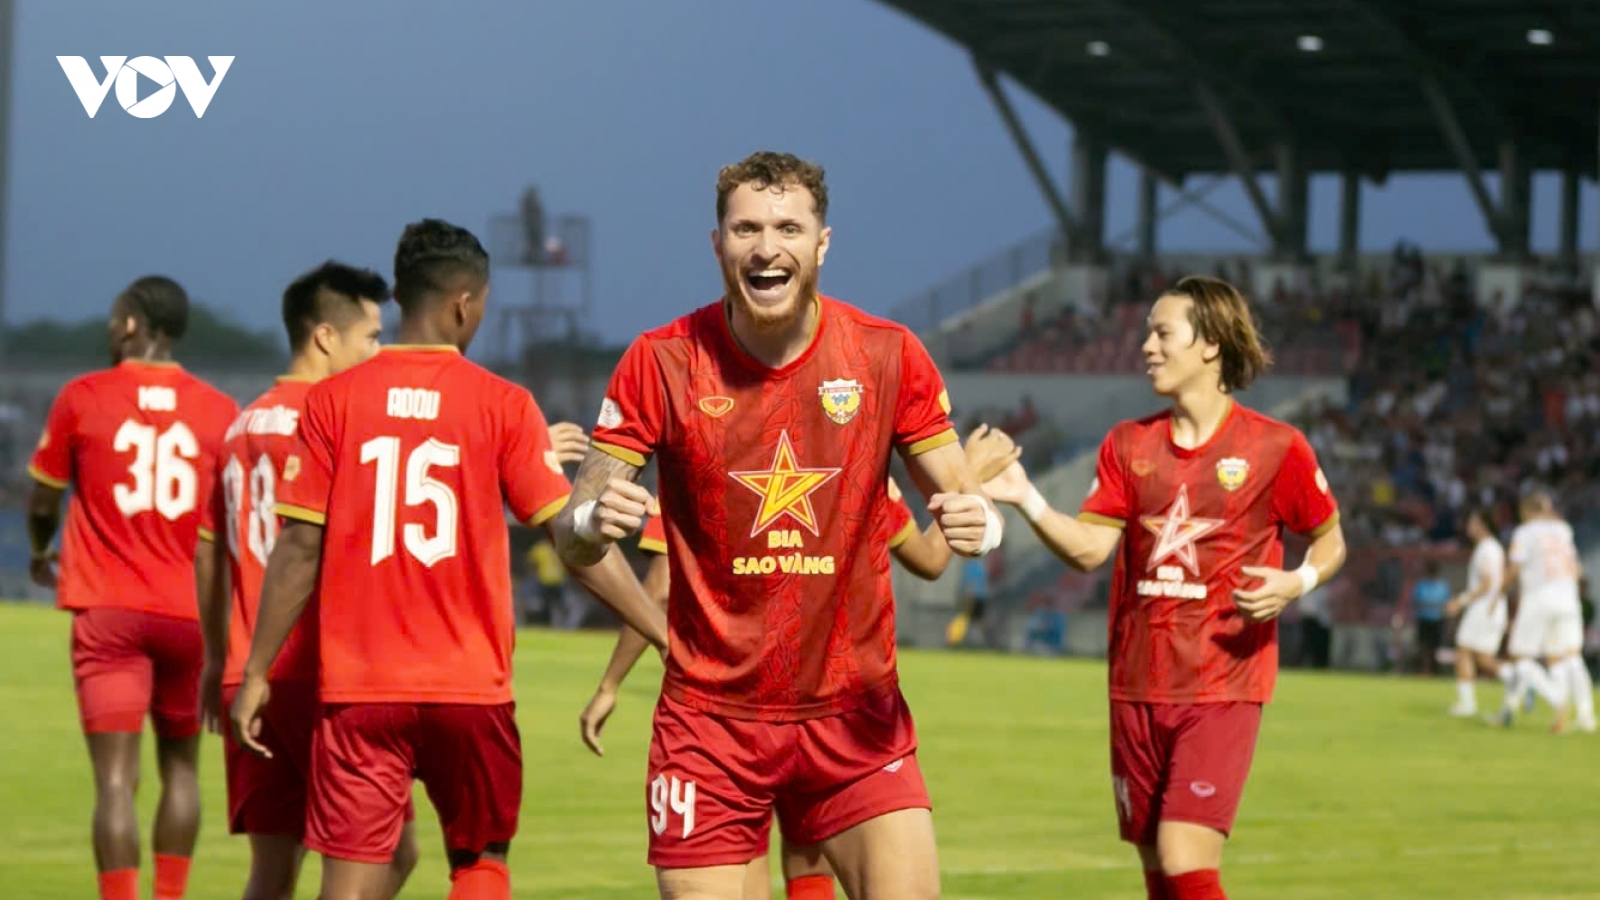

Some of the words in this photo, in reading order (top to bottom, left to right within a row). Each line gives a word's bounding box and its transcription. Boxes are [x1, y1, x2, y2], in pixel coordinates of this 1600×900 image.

[113, 418, 200, 521] 36
[360, 436, 460, 568] 15
[732, 556, 777, 575] SAO
[778, 551, 835, 575] VÀNG
[768, 529, 804, 549] BIA
[651, 773, 696, 840] 94
